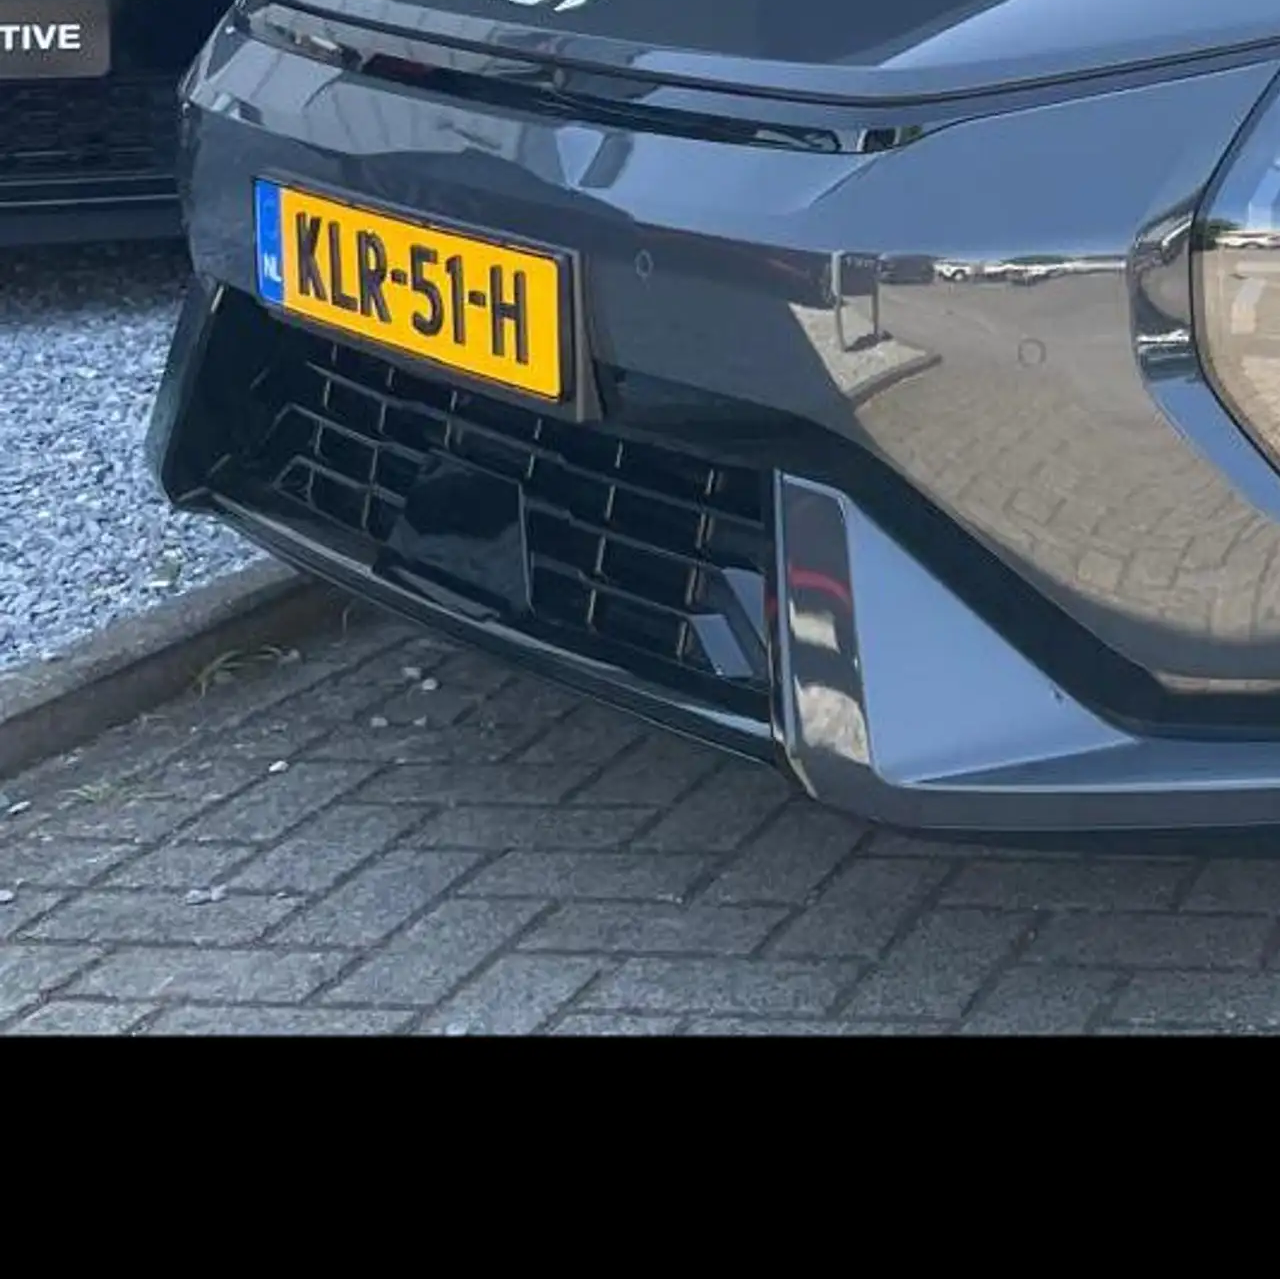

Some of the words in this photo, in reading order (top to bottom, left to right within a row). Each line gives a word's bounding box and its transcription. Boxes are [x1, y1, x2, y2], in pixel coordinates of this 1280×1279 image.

[0, 24, 81, 50] TIVE
[263, 252, 282, 283] NL
[295, 211, 530, 366] KLR-51-H
